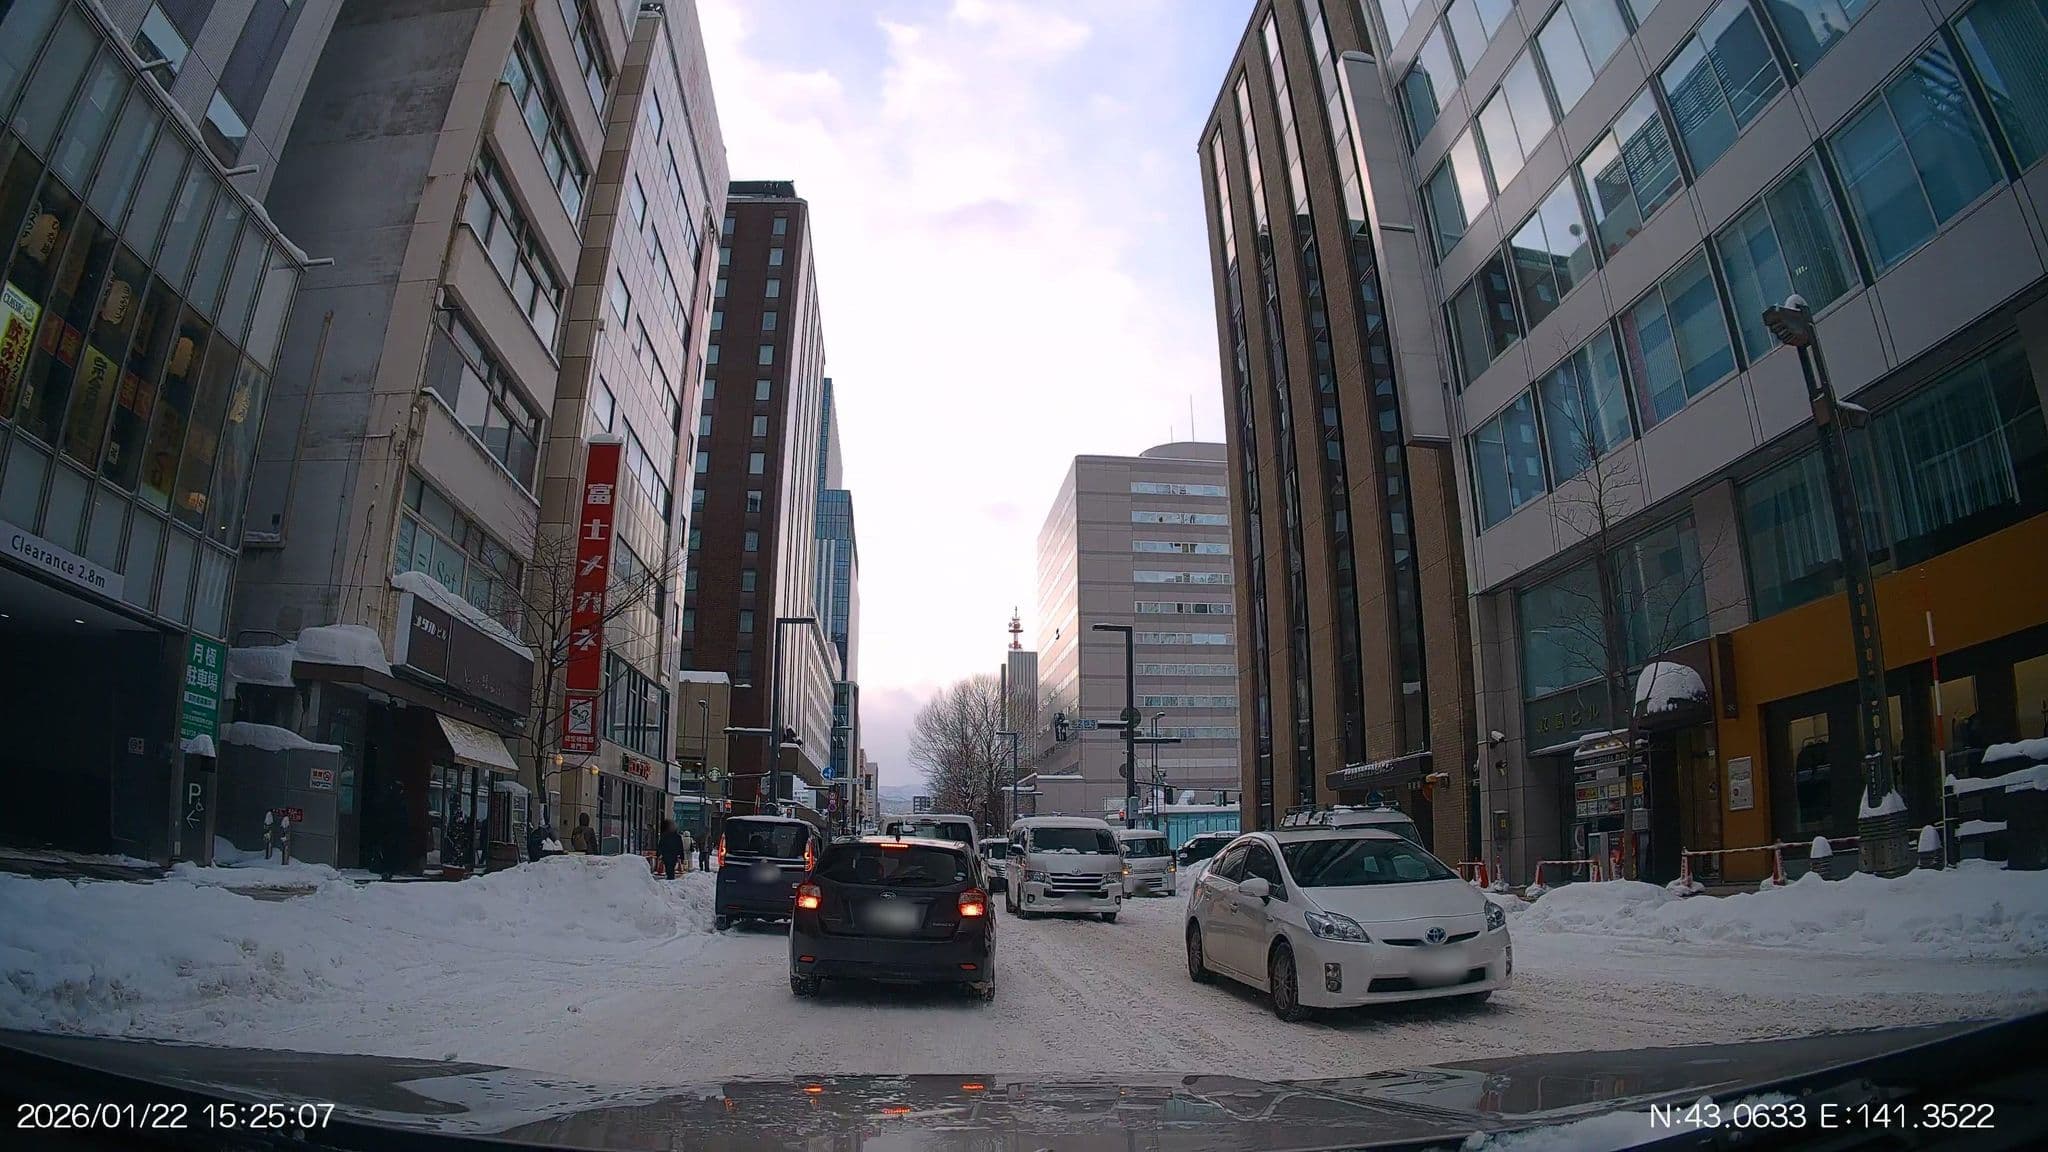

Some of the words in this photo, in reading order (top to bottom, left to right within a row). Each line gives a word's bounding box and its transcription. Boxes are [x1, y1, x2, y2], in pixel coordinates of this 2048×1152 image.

[11, 534, 75, 574] Clearance
[78, 564, 106, 588] 2.8m
[573, 483, 614, 651] 富士メガネ
[193, 643, 217, 668] 月極
[186, 664, 218, 693] 駐車場
[188, 783, 202, 805] P
